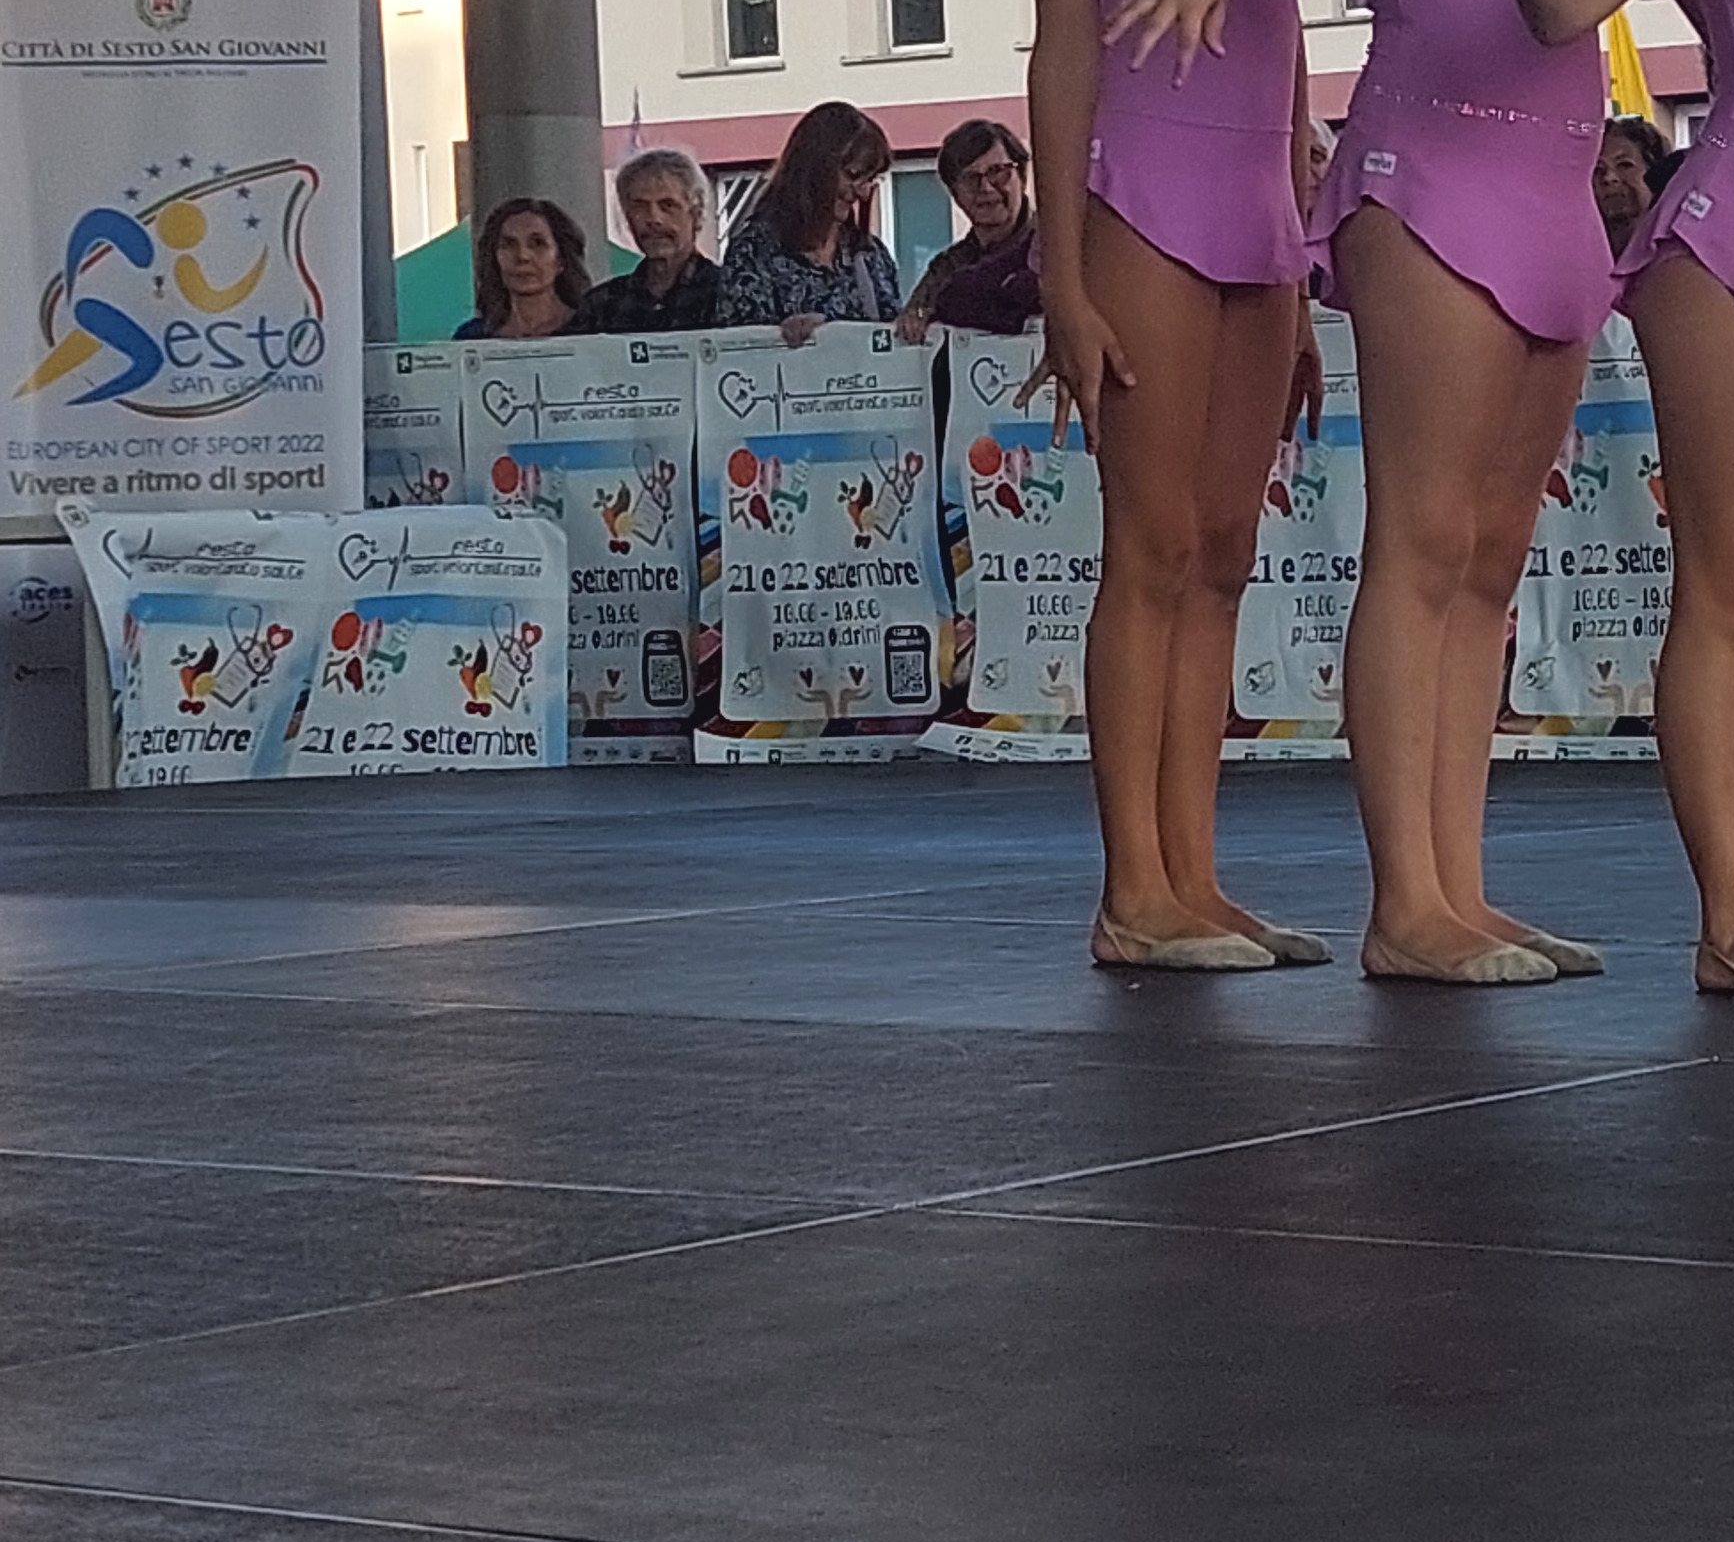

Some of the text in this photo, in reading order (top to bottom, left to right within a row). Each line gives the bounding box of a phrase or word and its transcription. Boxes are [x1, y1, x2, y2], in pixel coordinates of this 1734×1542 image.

[102, 39, 164, 57] SESTO
[171, 39, 211, 56] SAN
[218, 39, 326, 56] GIOVANNI
[8, 434, 324, 460] EUROPEAN CITY OF SPORT 2022
[10, 469, 96, 496] Vivere
[103, 474, 118, 493] a
[127, 468, 201, 493] ritmo
[209, 466, 236, 491] di
[979, 552, 1008, 582] 21
[1015, 557, 1028, 582] e
[1035, 552, 1062, 581] 22
[1281, 557, 1295, 583] e
[1301, 552, 1327, 582] 22
[1560, 549, 1575, 576] e
[1580, 543, 1609, 574] 22
[1615, 541, 1671, 574] sette
[571, 562, 678, 593] settembre
[728, 557, 919, 592] 21 e 22 settembre
[772, 625, 825, 652] piazza
[1572, 617, 1627, 642] piazza
[300, 722, 538, 756] 21 e 22 settembre
